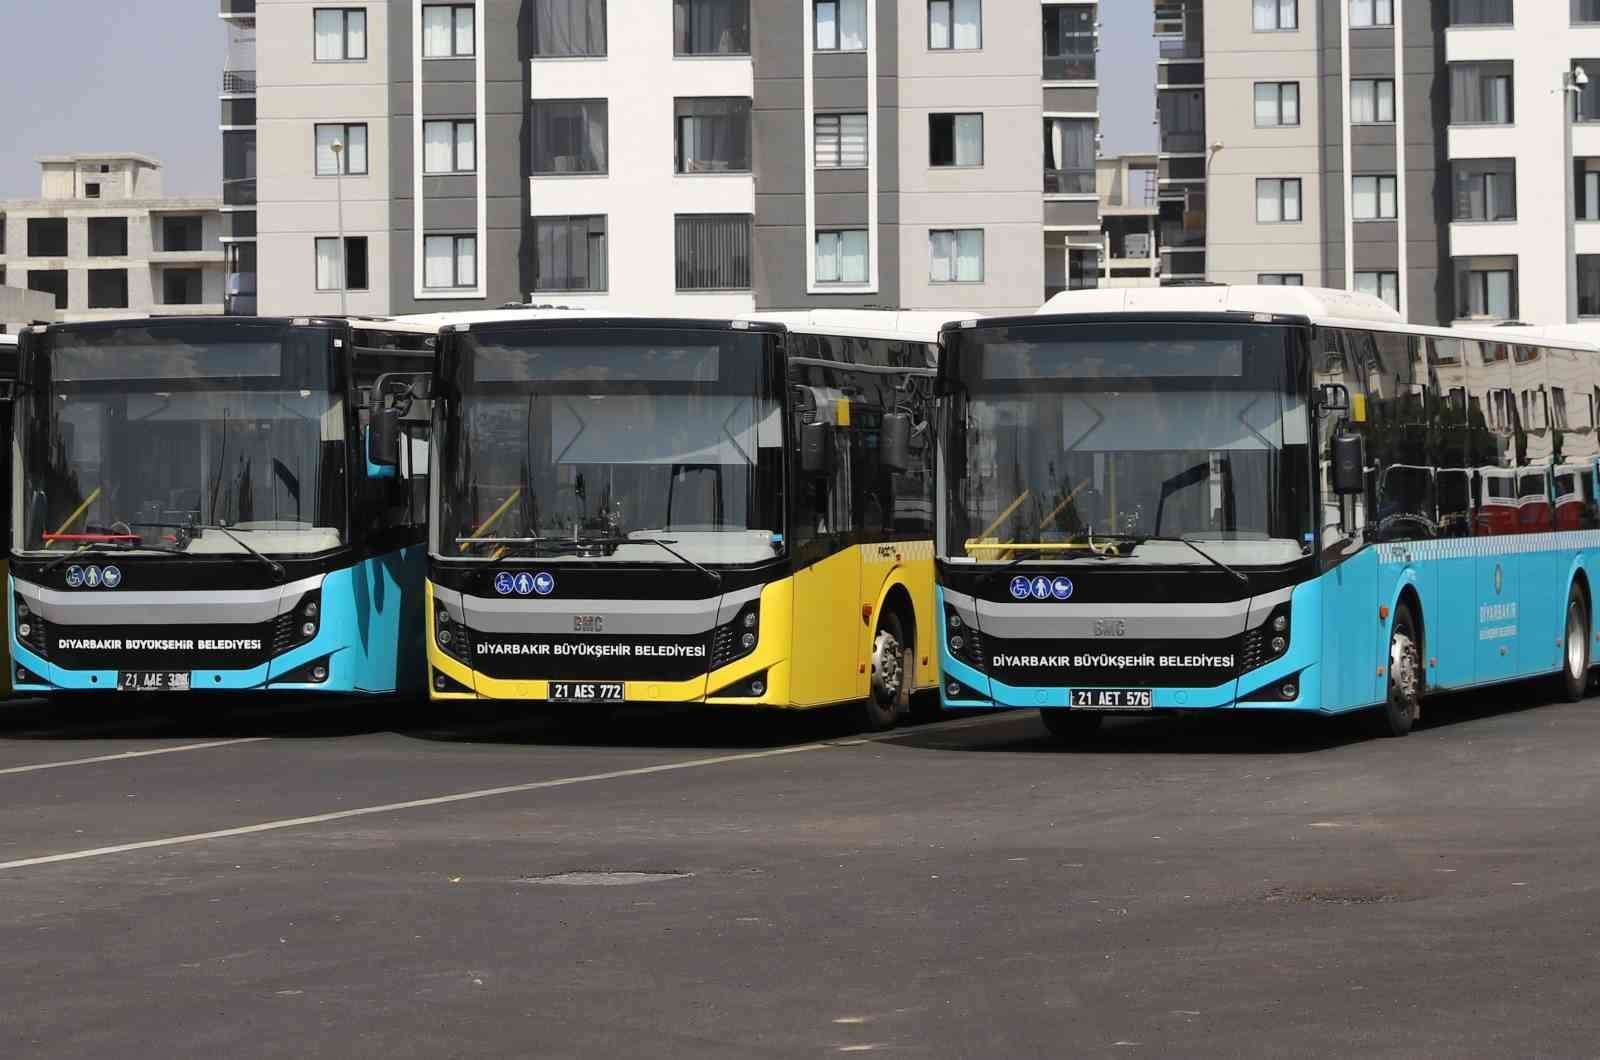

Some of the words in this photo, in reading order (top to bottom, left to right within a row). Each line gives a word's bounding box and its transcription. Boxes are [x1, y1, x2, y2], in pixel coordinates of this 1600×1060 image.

[58, 638, 122, 650] DİYARBAKIR
[197, 638, 262, 650] BELEDİYESİ
[476, 642, 551, 655] DİYARBAKIR
[553, 642, 631, 658] BÜYÜKŞEHİR
[634, 643, 706, 657] BELEDİYESİ
[992, 653, 1071, 668] DİYARBAKIR
[1073, 653, 1156, 670] BÜYÜKŞEHİR
[1159, 653, 1235, 668] BELEDİYESİ
[125, 673, 138, 687] 21
[555, 684, 569, 699] 21
[574, 684, 595, 699] AES
[599, 684, 621, 699] 772
[1078, 692, 1092, 706] 21
[1098, 692, 1119, 706] AET
[1126, 692, 1149, 706] 576
